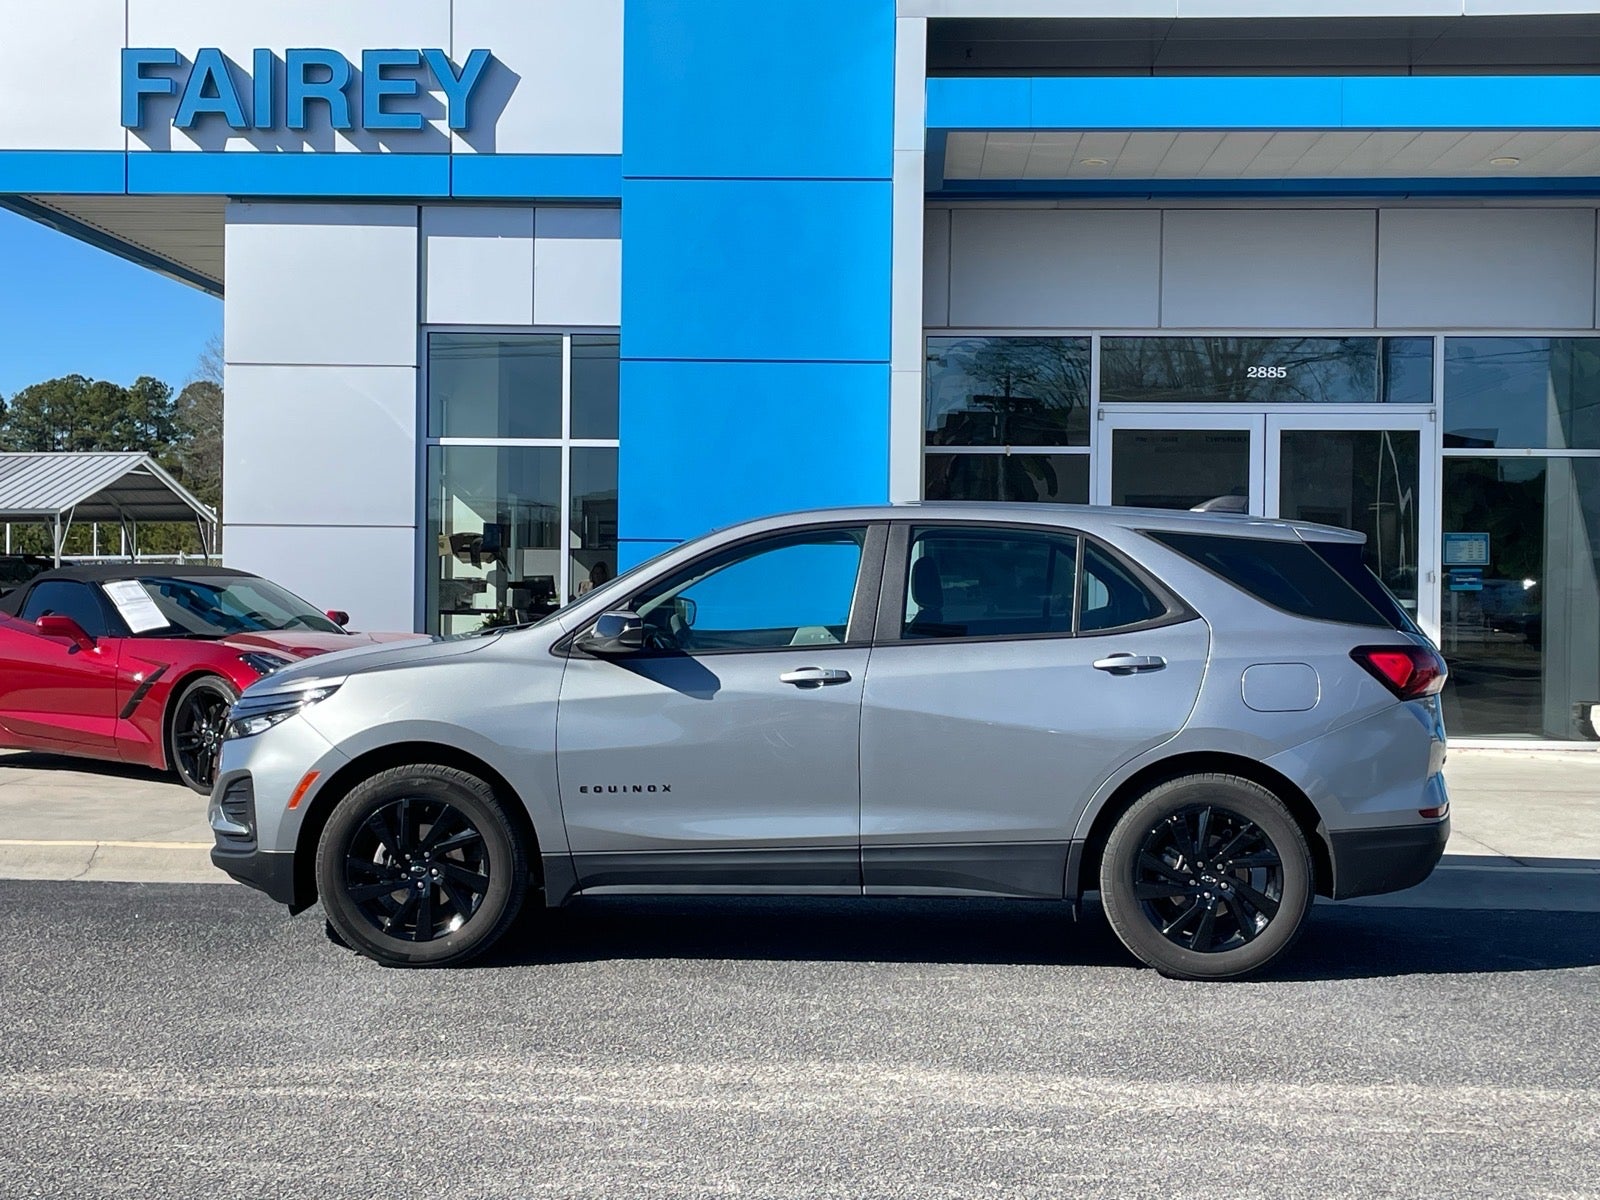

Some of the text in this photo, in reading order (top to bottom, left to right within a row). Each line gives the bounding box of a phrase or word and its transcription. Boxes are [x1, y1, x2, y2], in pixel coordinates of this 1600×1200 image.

[121, 48, 491, 131] FAIREY
[1247, 366, 1287, 378] 2885
[579, 784, 672, 794] EQUINOX
